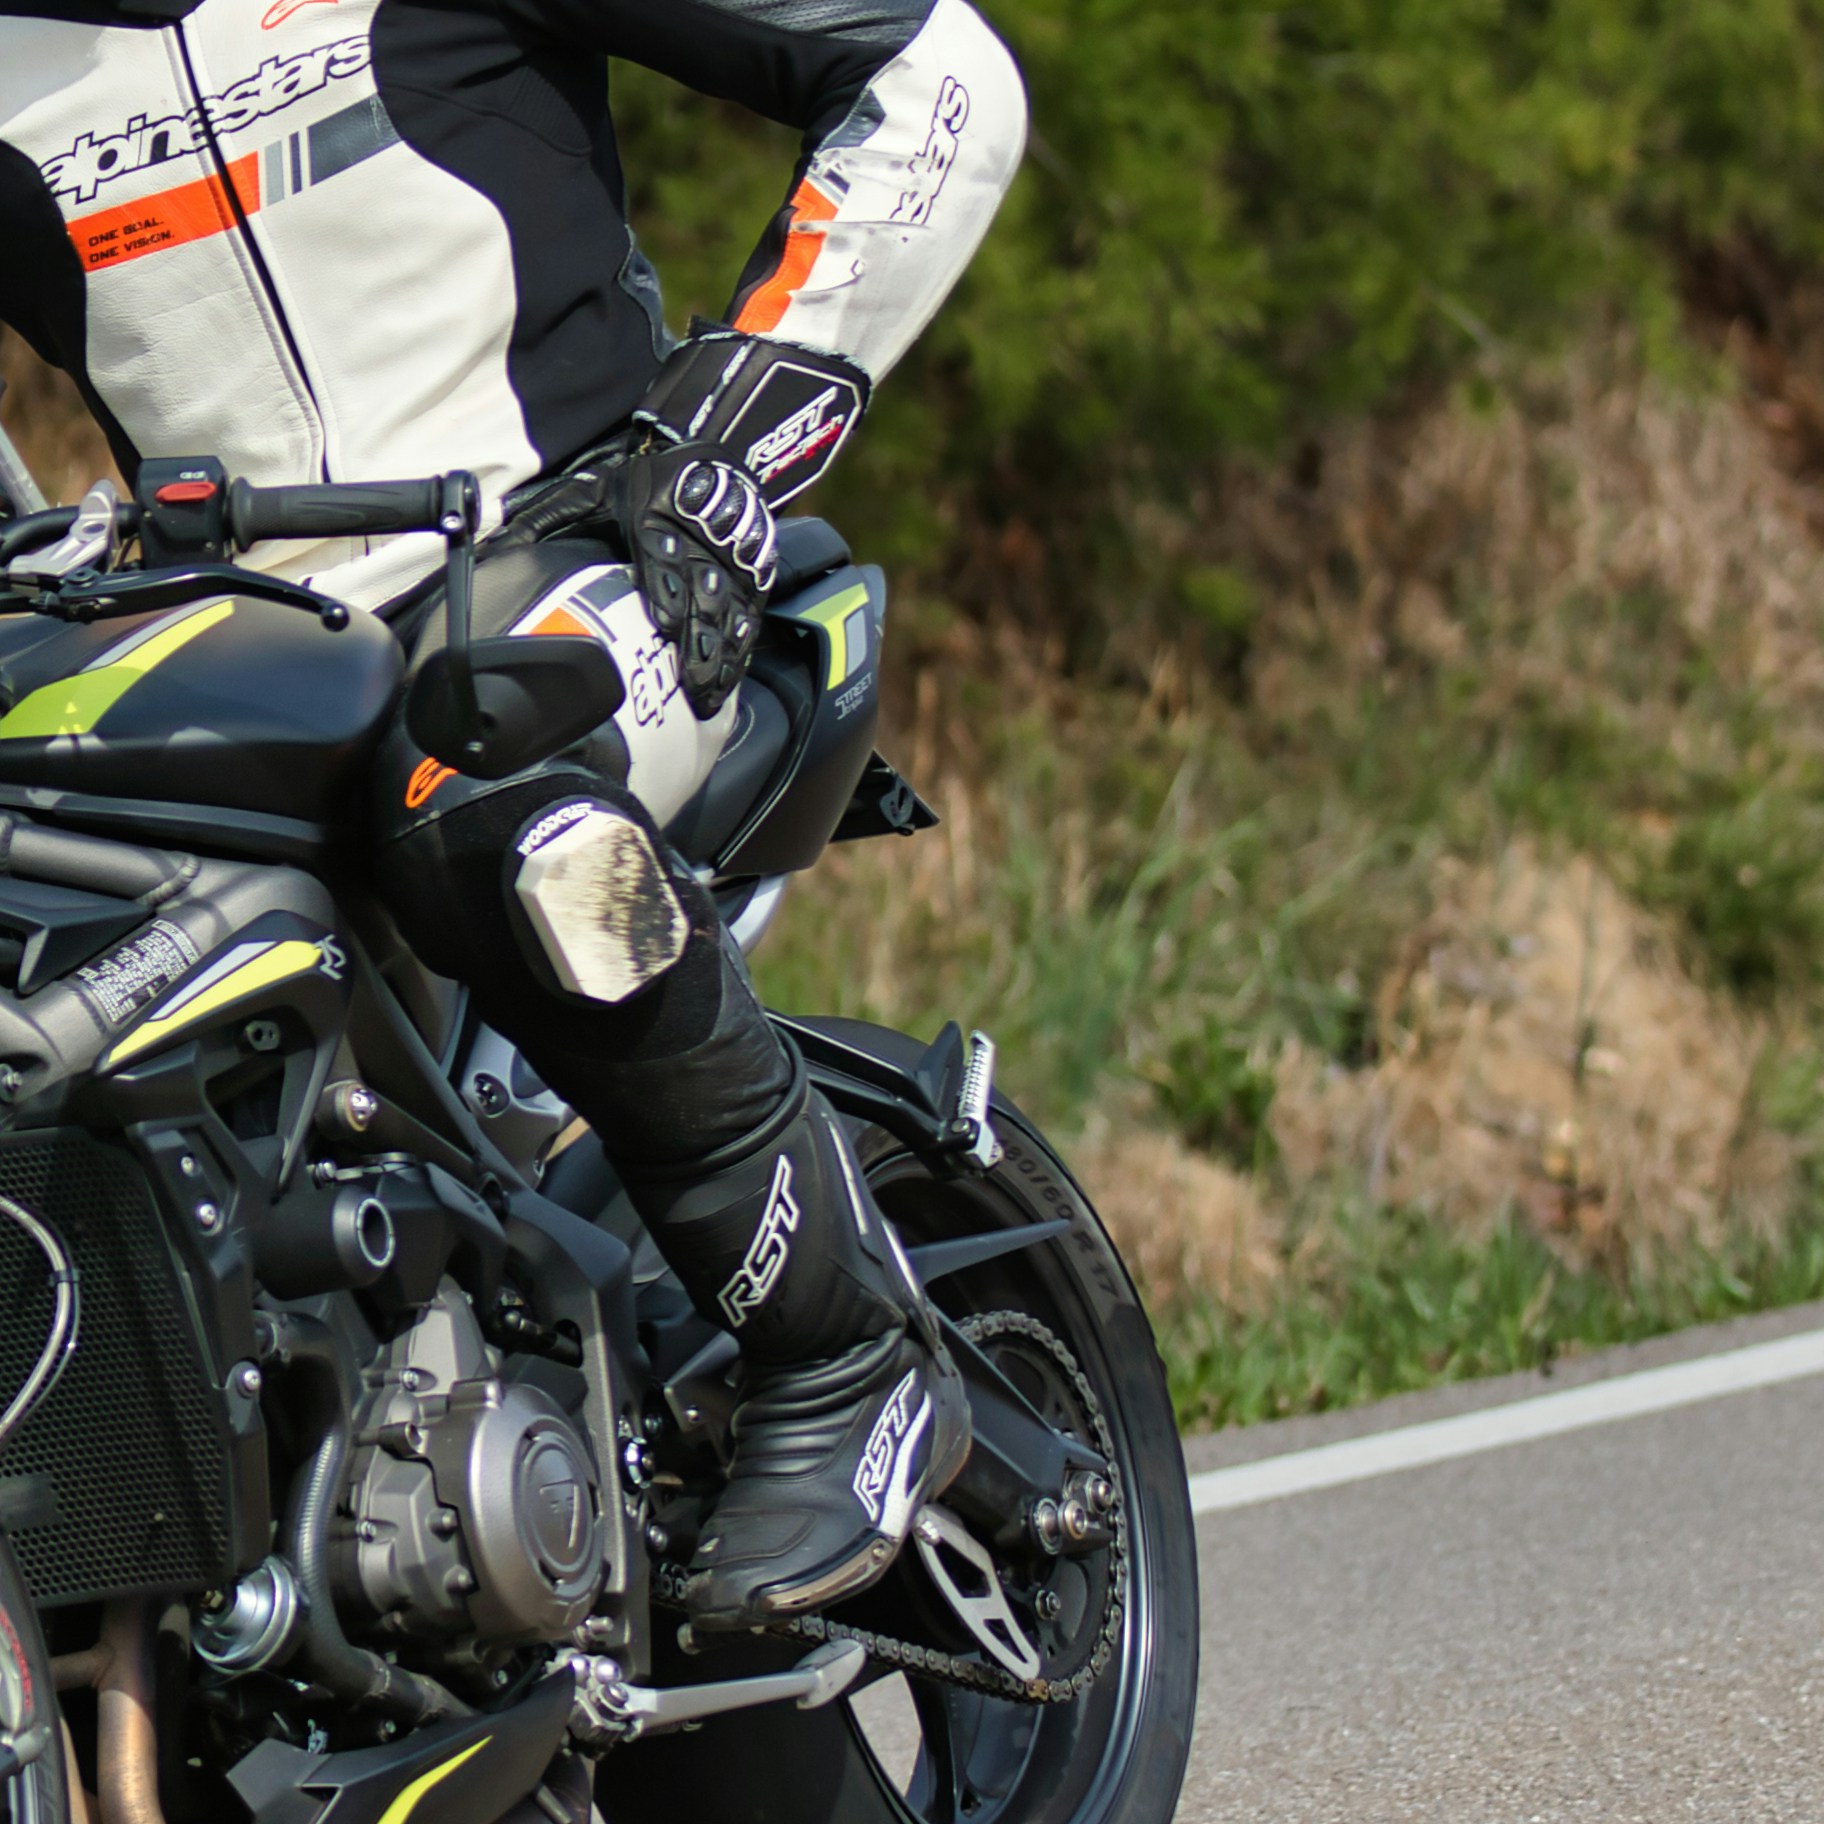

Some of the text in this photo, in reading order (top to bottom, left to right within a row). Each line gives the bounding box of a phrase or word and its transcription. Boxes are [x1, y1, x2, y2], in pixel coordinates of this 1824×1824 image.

[88, 228, 119, 247] ONE
[89, 246, 119, 264] ONE
[744, 386, 838, 472] RST
[716, 1153, 801, 1327] RST
[851, 1367, 918, 1523] RST
